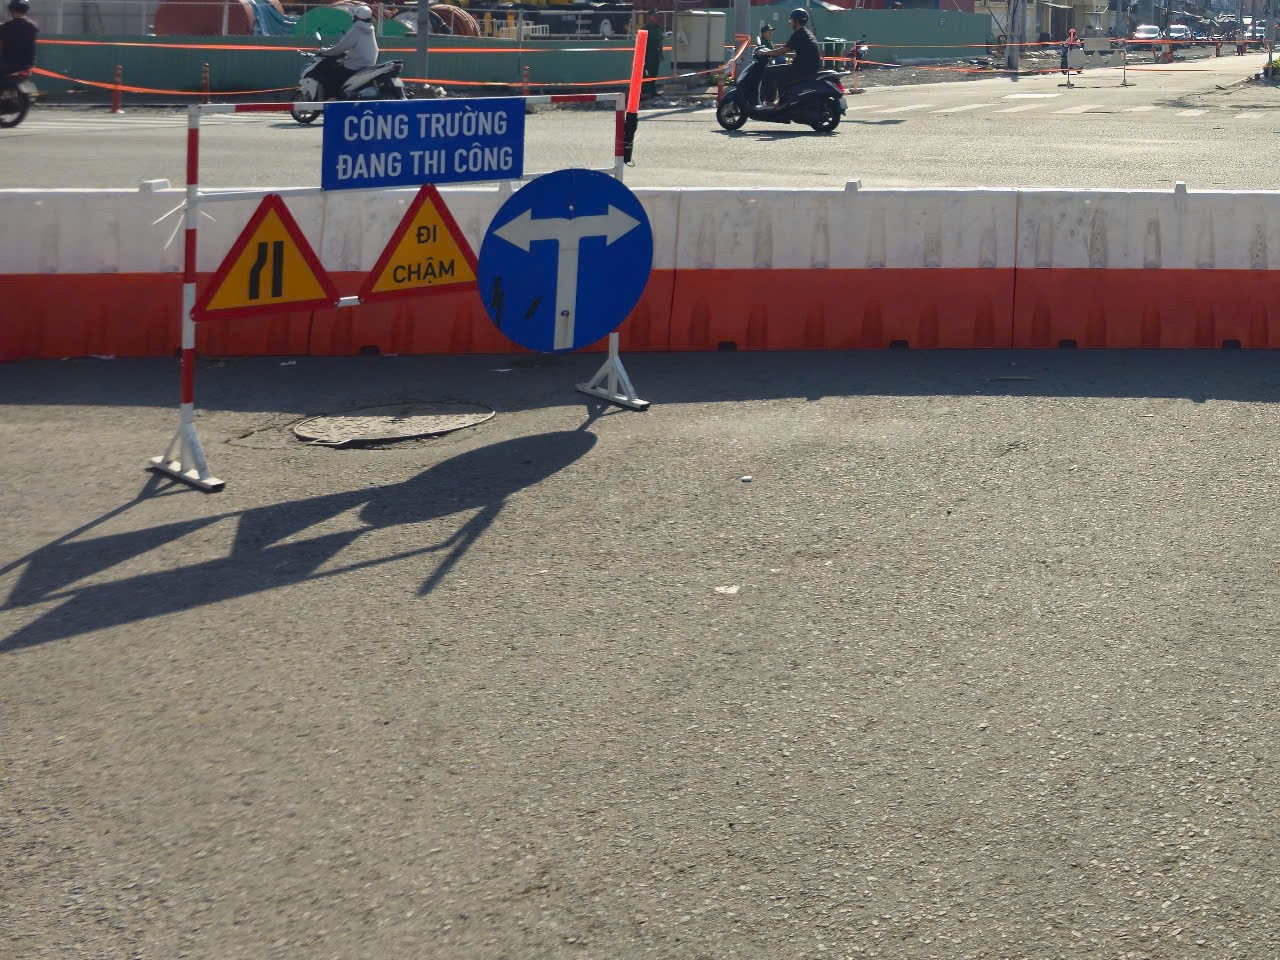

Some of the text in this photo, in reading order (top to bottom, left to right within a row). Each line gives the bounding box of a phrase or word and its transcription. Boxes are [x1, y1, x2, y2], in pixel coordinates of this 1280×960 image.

[344, 105, 508, 141] CÔNG TRƯỜNG
[336, 142, 513, 180] ĐANG THI CÔNG
[416, 225, 437, 244] ĐI
[393, 256, 455, 284] CHẬM
